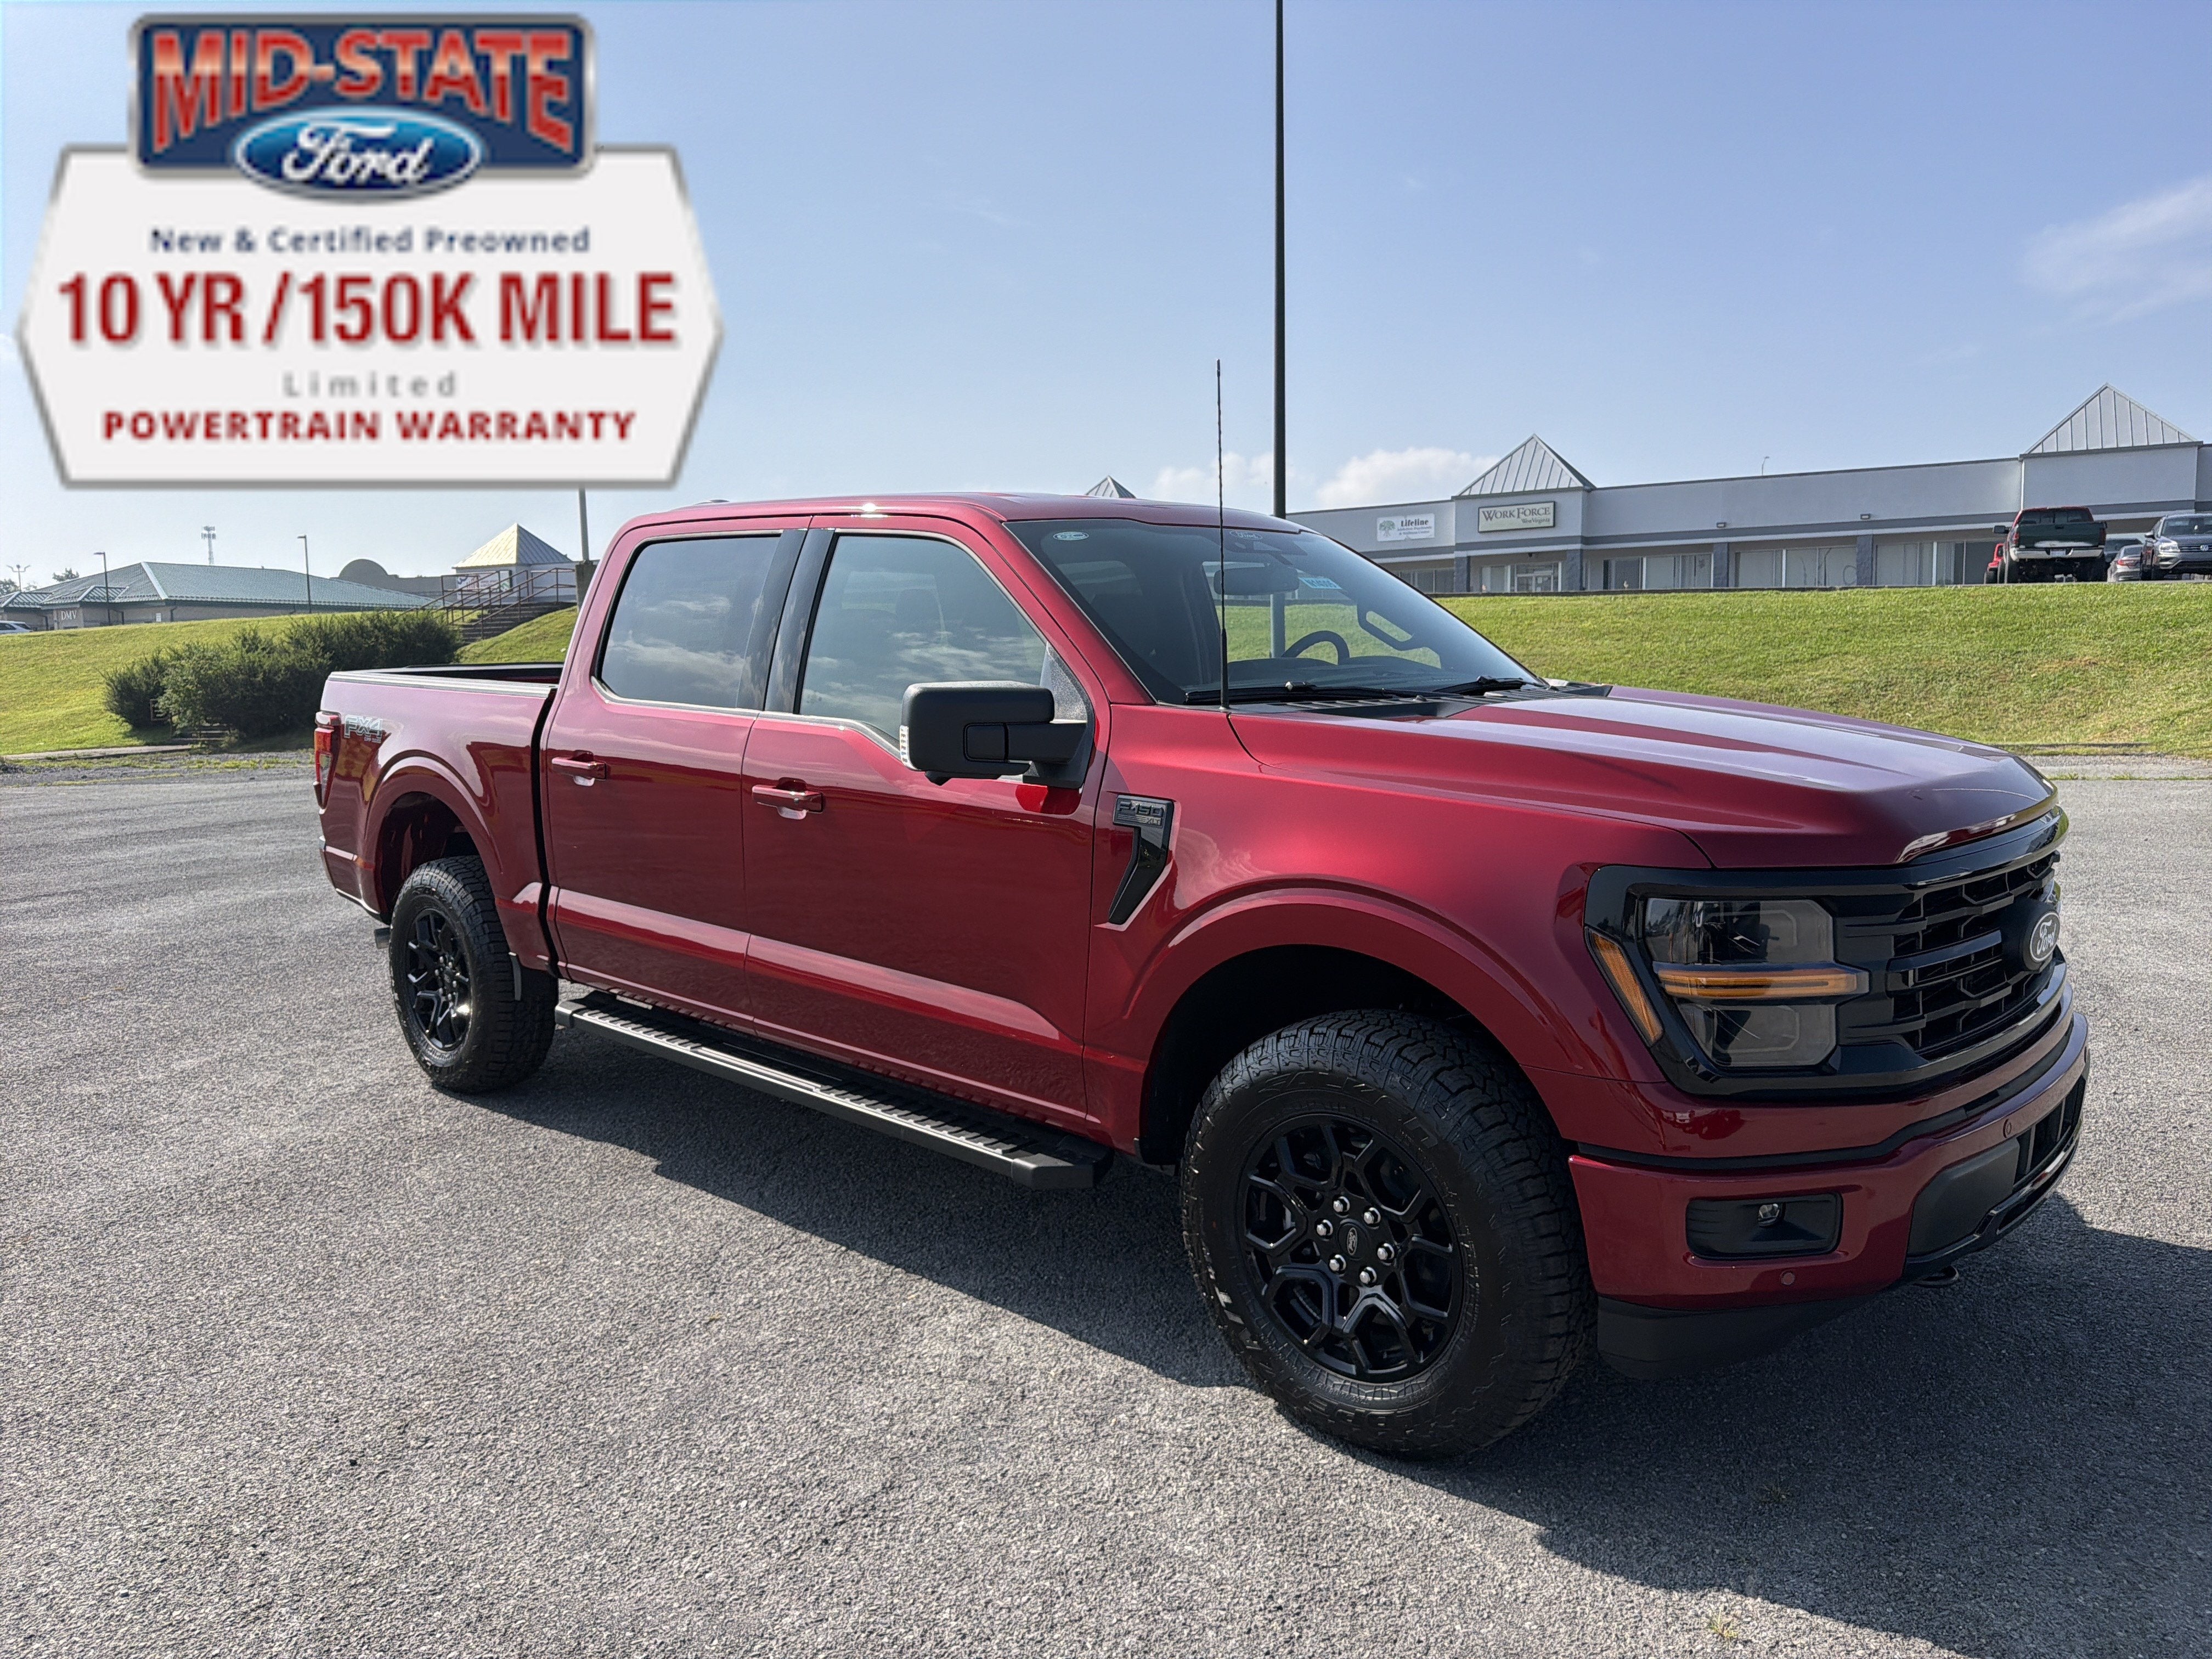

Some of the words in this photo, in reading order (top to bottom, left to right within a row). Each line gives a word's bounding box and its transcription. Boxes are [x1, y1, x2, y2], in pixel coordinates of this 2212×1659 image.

[1401, 518, 1429, 527] Lifeline
[61, 610, 77, 620] DMV
[344, 714, 383, 738] FX4
[2037, 919, 2056, 955] Ford
